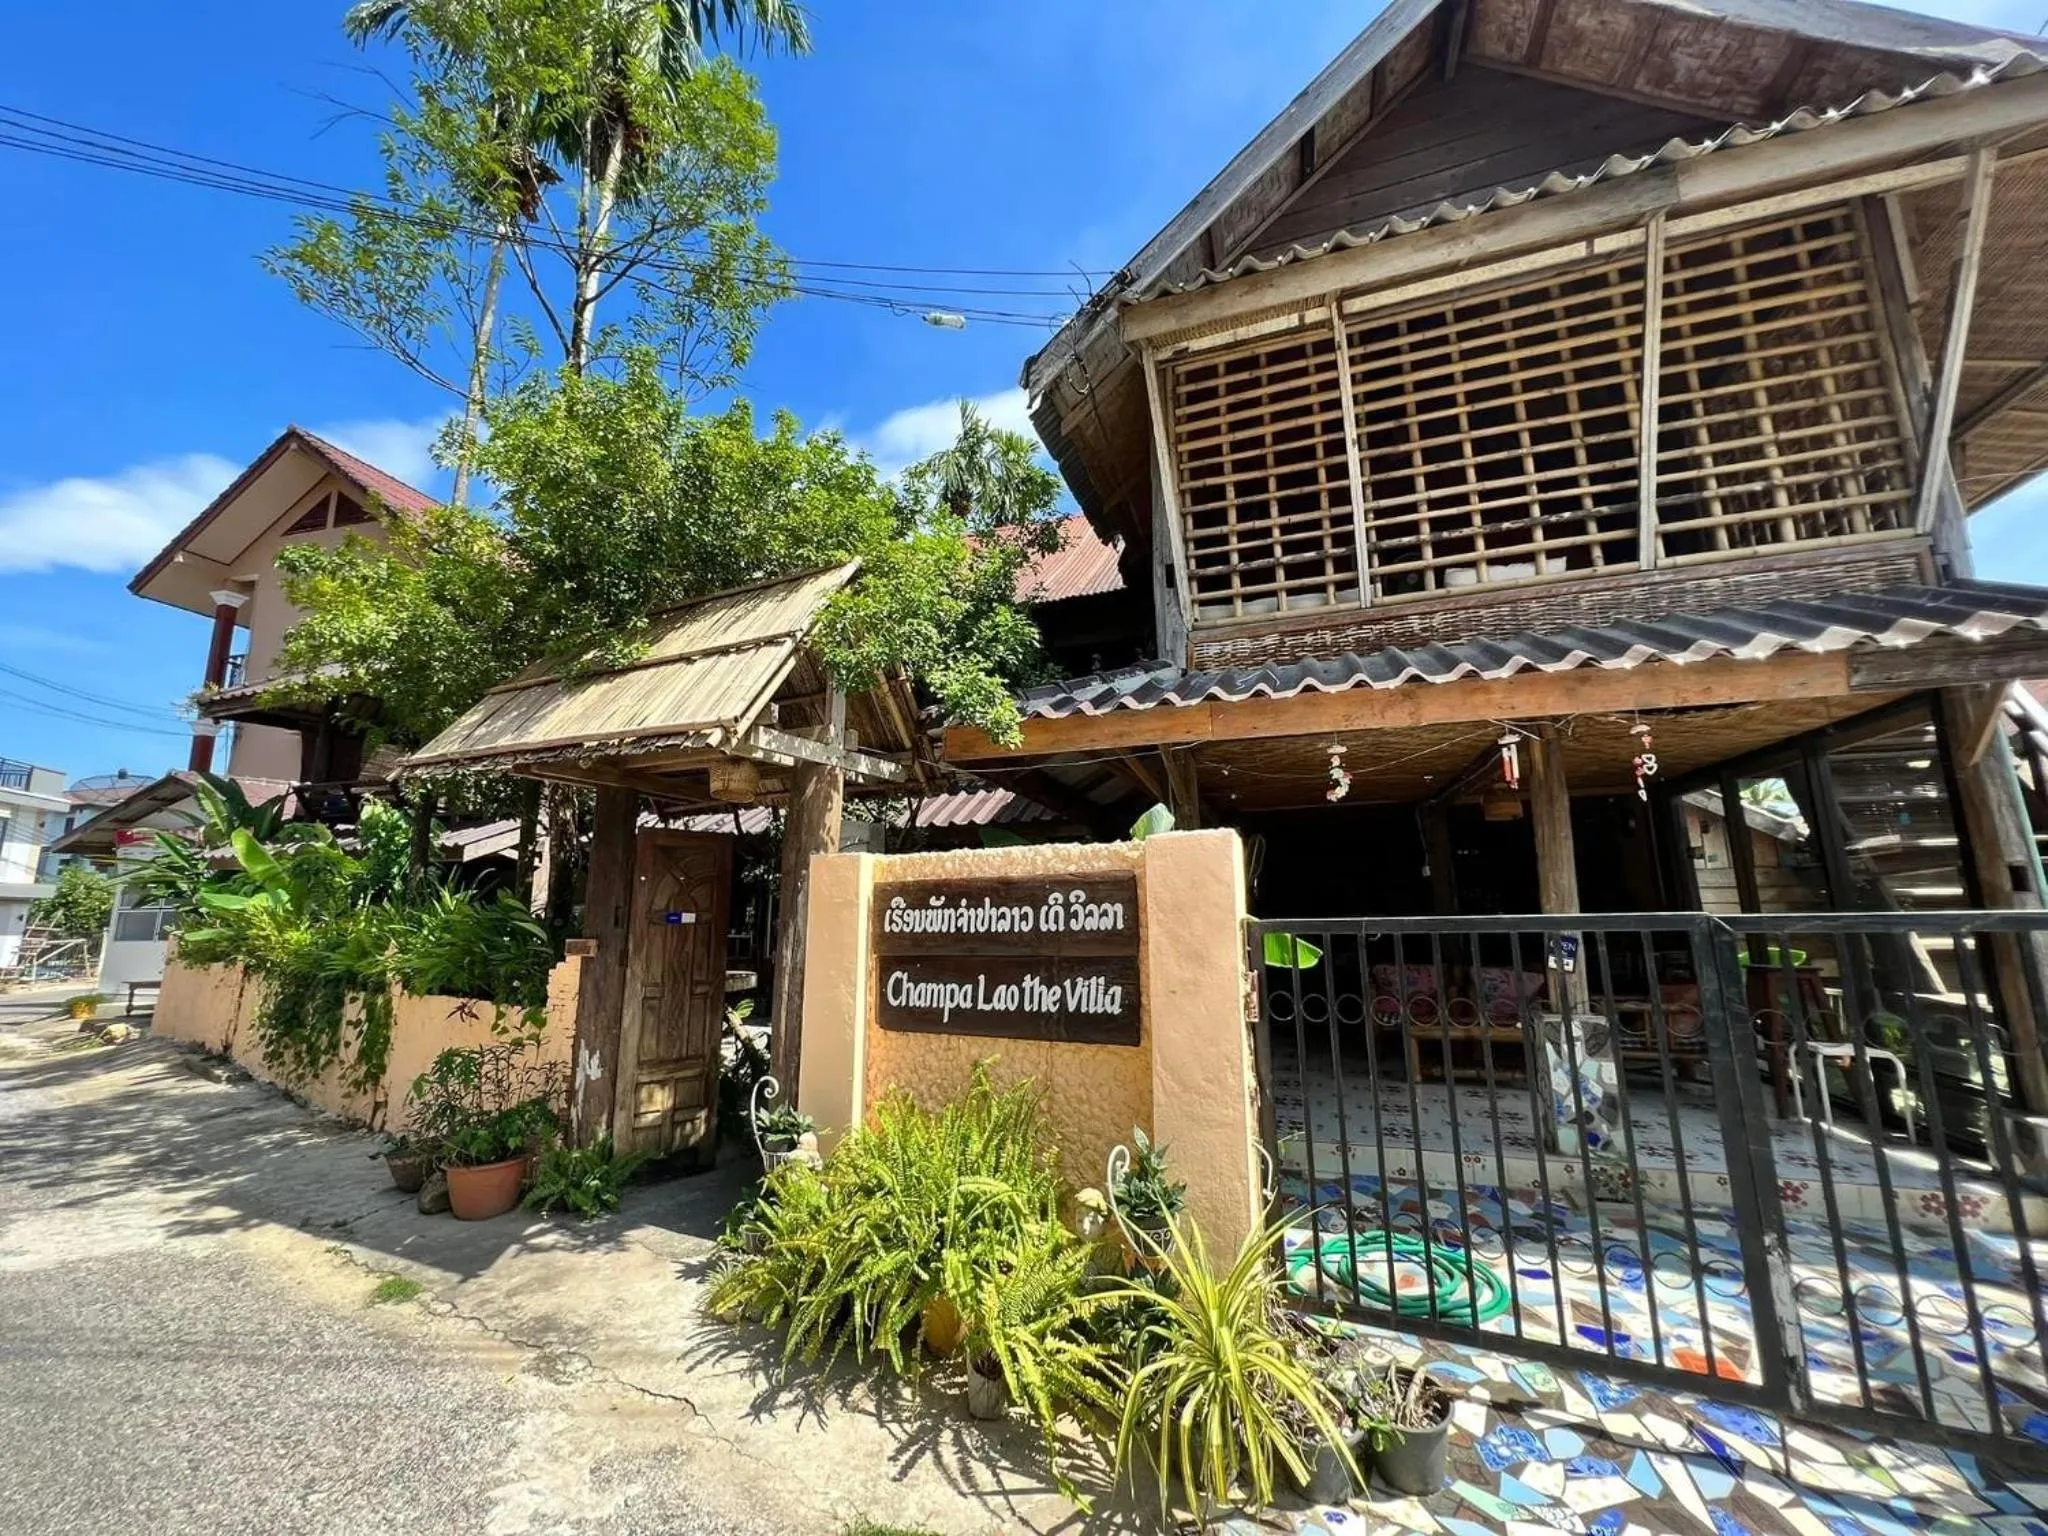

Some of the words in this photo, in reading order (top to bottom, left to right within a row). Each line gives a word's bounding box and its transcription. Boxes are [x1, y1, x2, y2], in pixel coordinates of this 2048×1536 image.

[886, 970, 973, 1023] Champa
[977, 974, 1019, 1010] Lao
[1022, 973, 1060, 1012] the
[1063, 976, 1122, 1015] Villa
